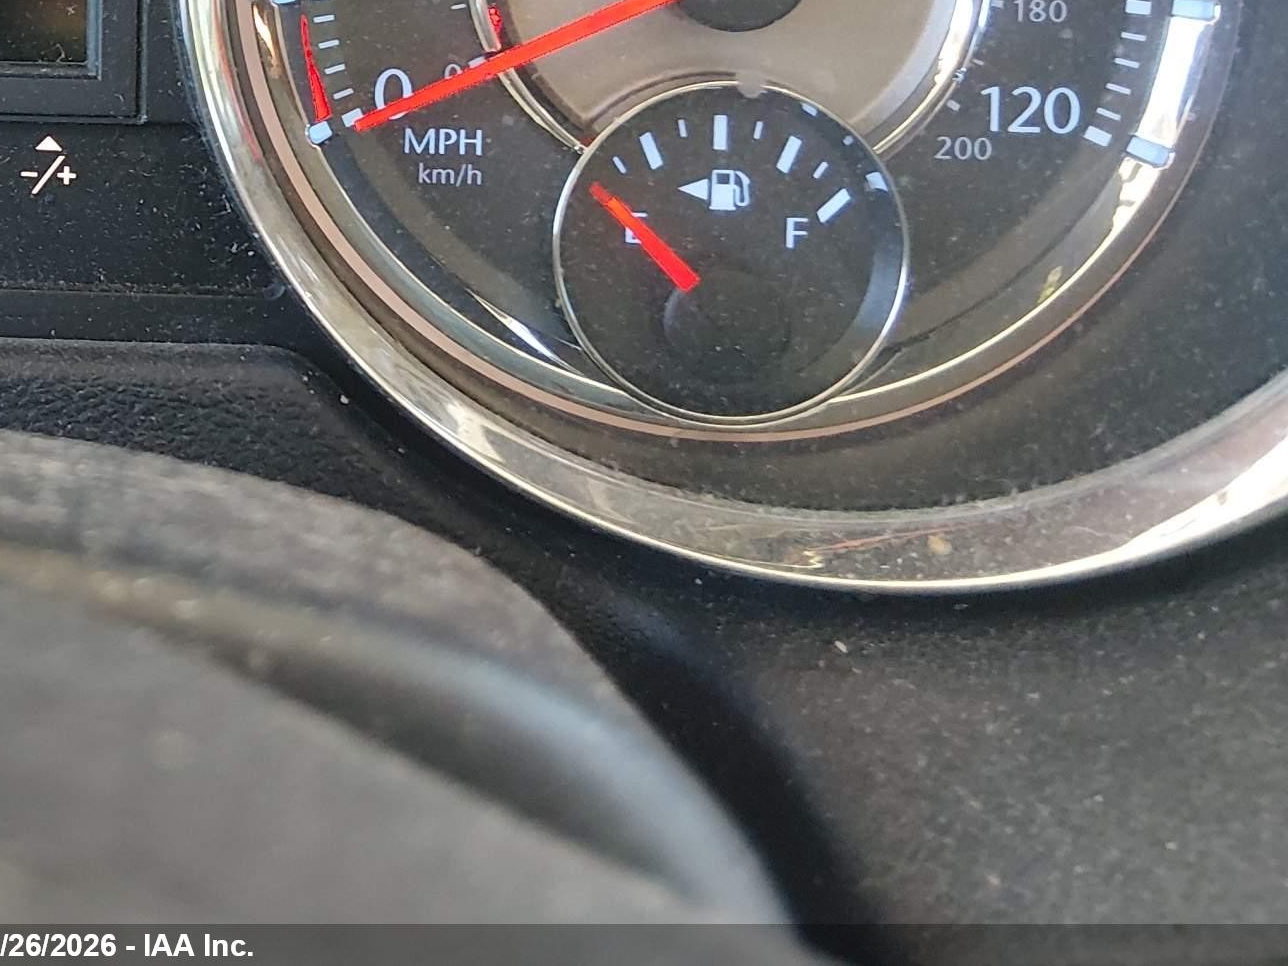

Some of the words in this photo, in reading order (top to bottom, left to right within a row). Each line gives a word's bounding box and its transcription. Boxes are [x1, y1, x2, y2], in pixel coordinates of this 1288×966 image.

[981, 86, 1080, 136] 120
[404, 128, 483, 155] MPH
[935, 136, 992, 161] 200
[418, 163, 482, 187] km/h
[785, 217, 809, 248] F
